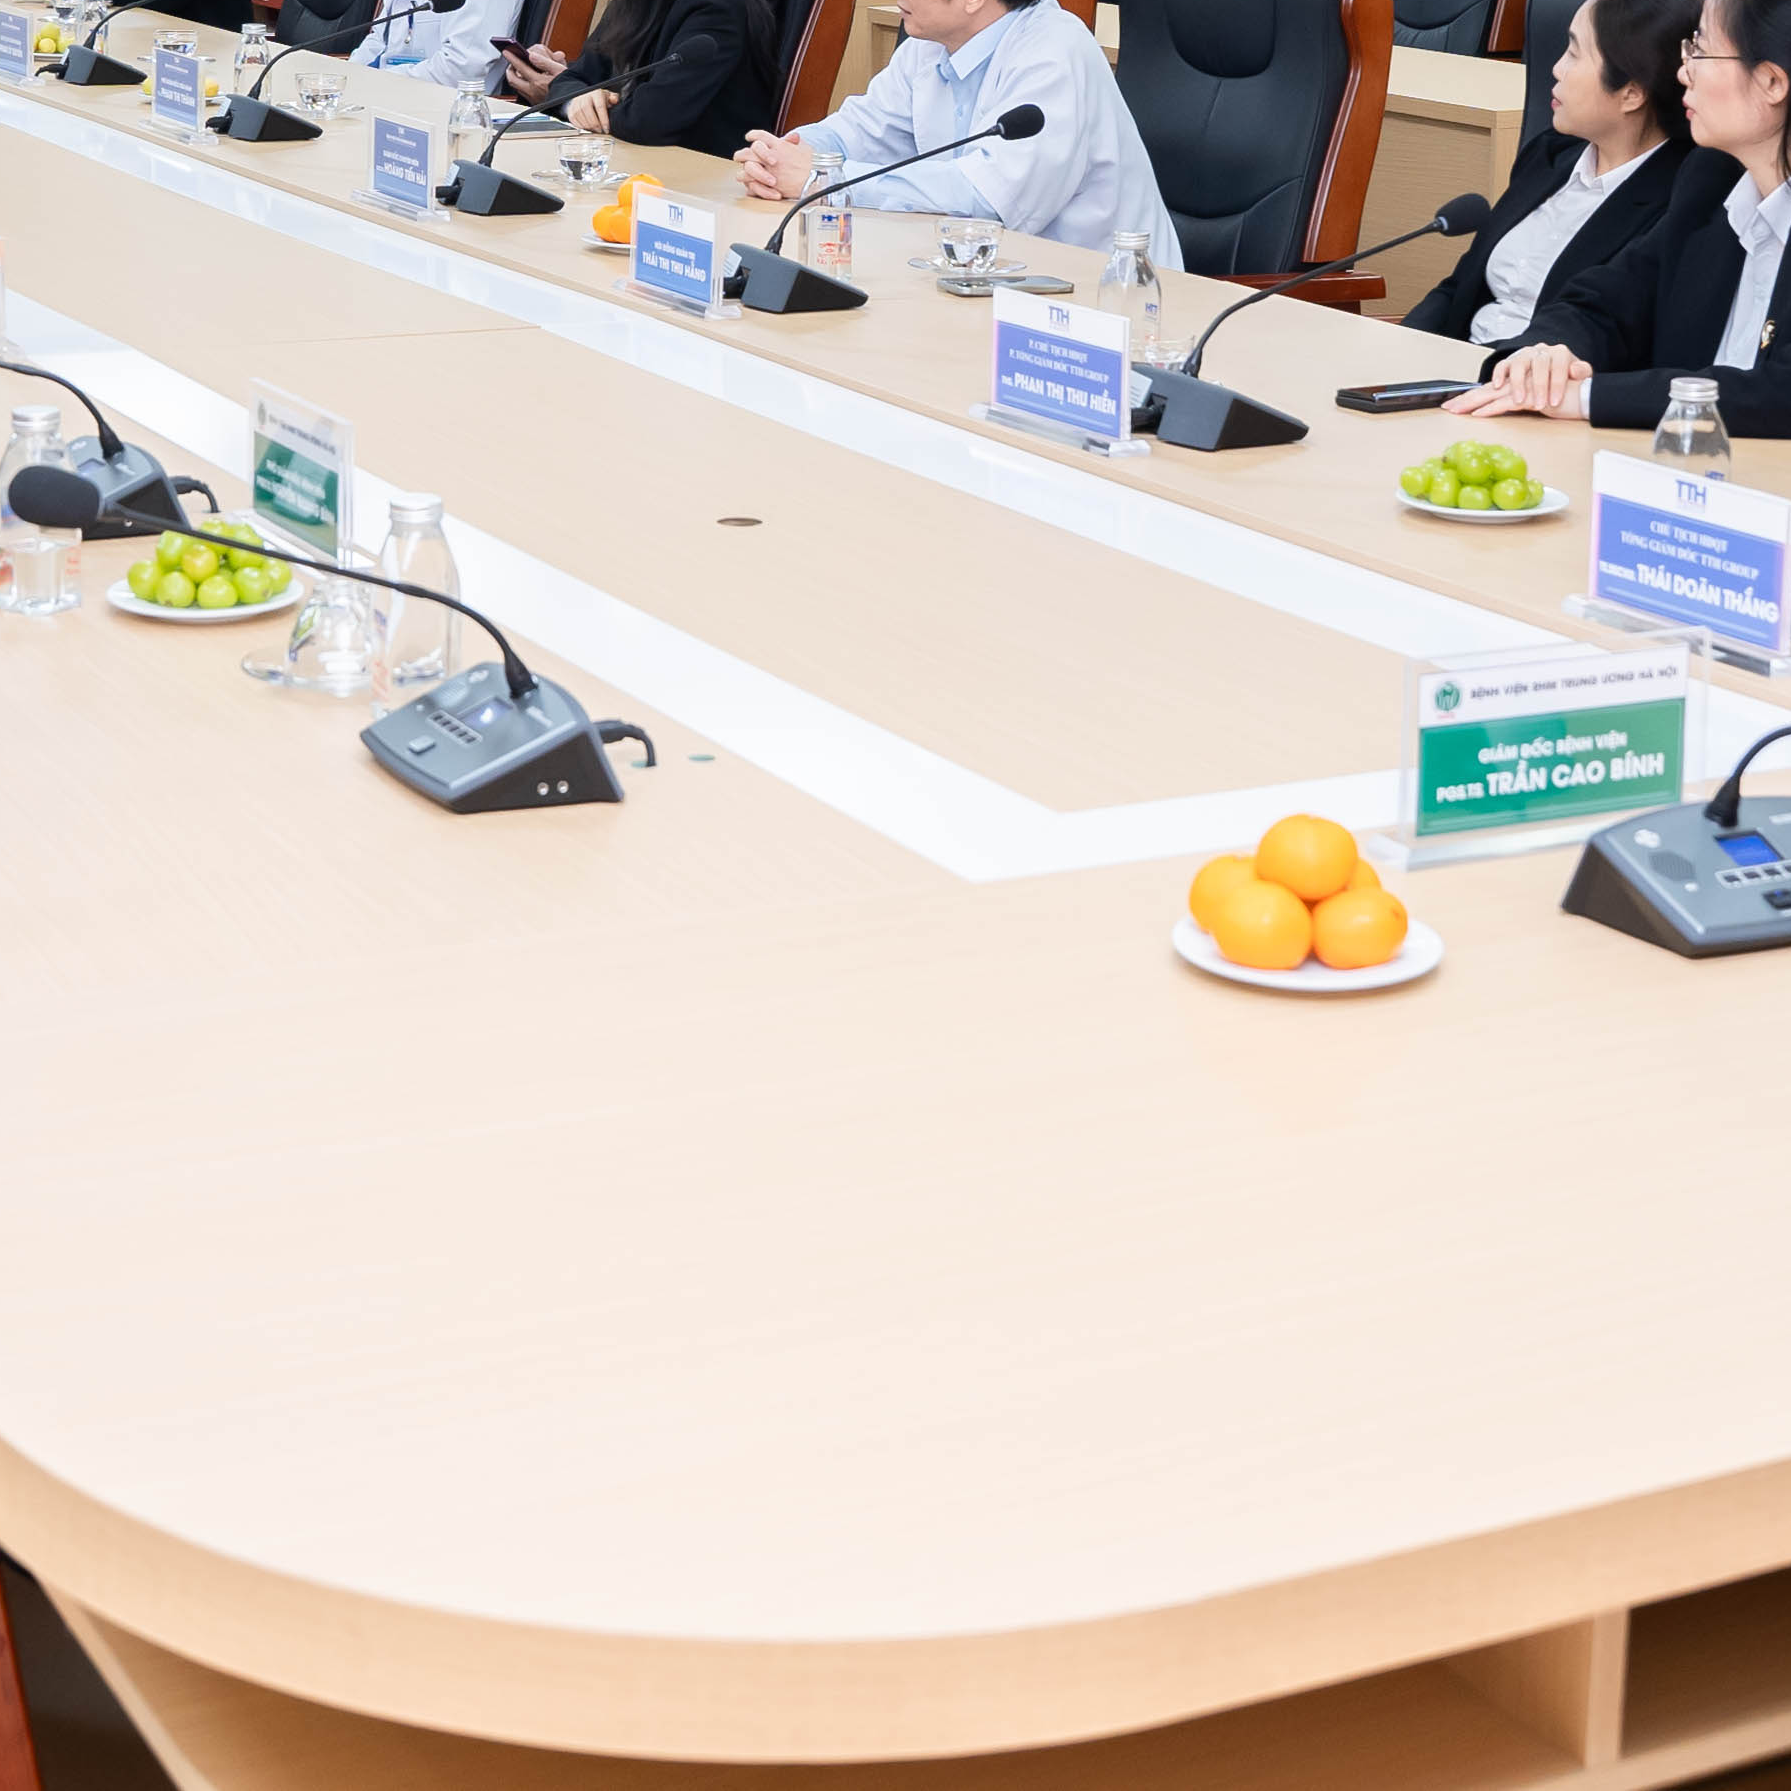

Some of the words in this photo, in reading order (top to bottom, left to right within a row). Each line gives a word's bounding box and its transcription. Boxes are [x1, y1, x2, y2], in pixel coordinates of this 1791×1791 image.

[1049, 306, 1070, 324] TTH
[1014, 372, 1045, 396] PHAN
[1046, 381, 1065, 405] THỊ
[1066, 386, 1088, 407] THU
[1675, 479, 1707, 505] TTH
[1637, 563, 1672, 593] THÁI
[1478, 742, 1518, 764] GIÁM
[1520, 736, 1554, 758] ĐỐC
[1556, 734, 1593, 756] BỆNH
[1595, 729, 1628, 751] VIỆN
[1551, 761, 1606, 788] CAO
